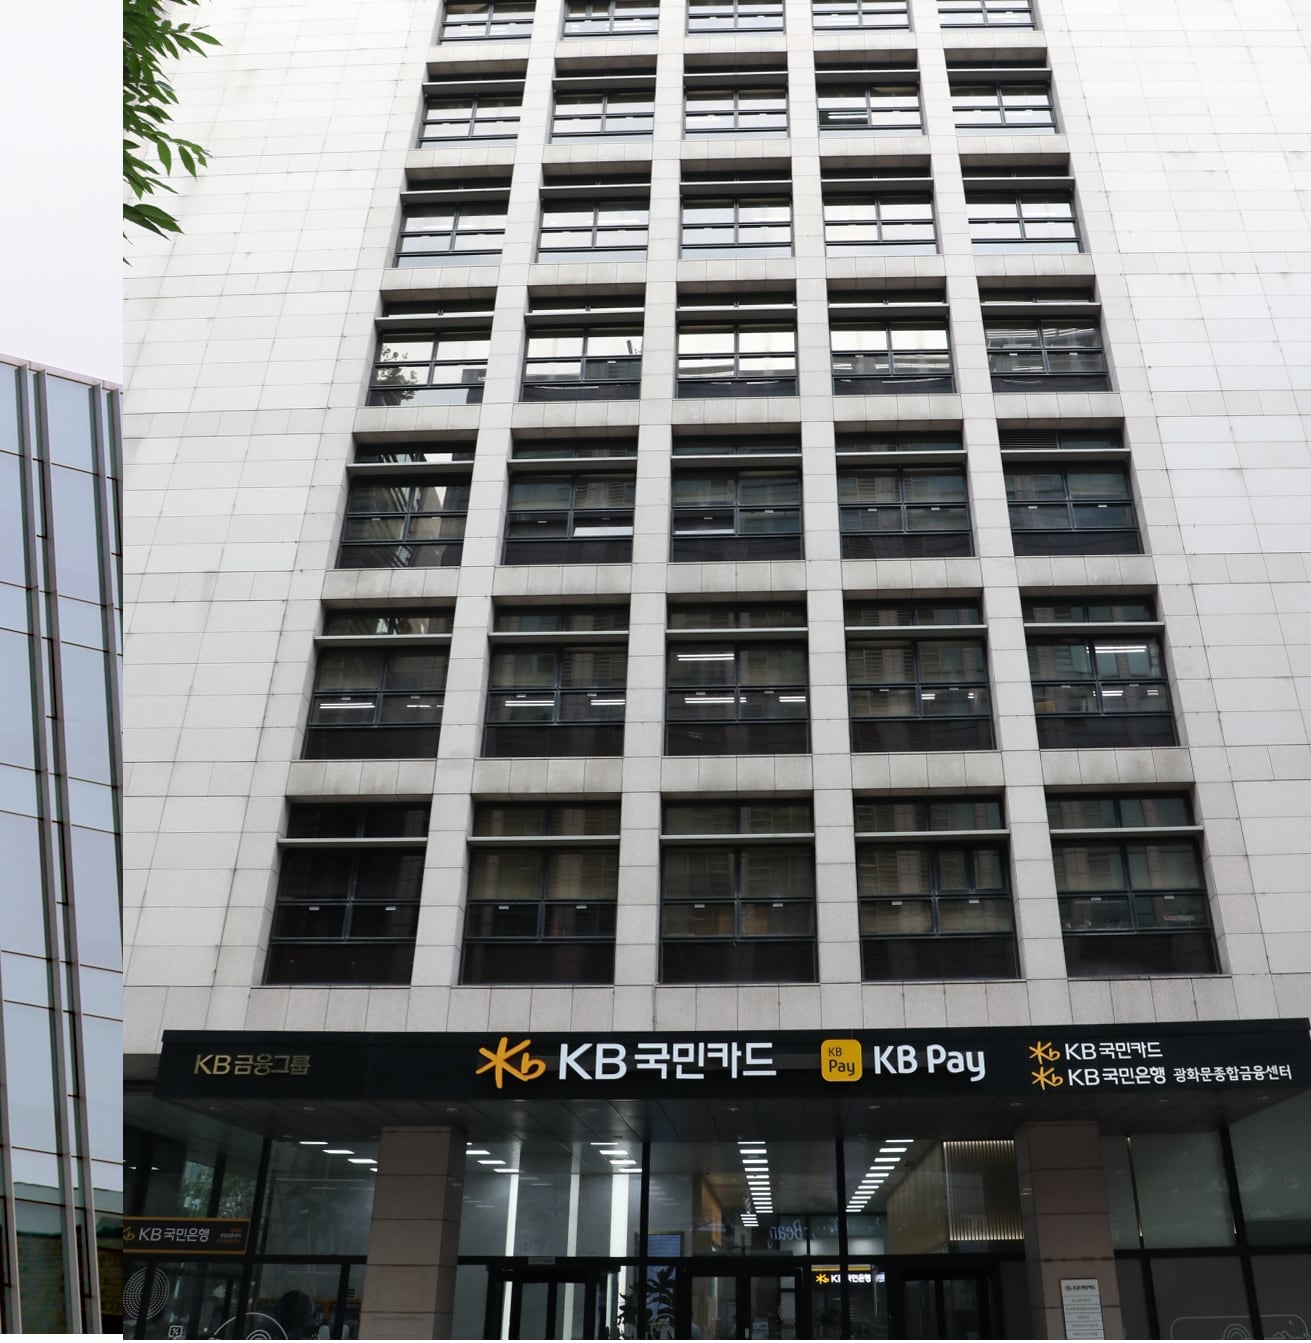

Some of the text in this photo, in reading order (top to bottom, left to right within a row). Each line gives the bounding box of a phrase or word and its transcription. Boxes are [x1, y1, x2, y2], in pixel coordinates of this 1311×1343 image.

[828, 1047, 843, 1057] KB
[828, 1059, 856, 1076] Pay
[873, 1044, 987, 1082] KB Pay
[1173, 1063, 1293, 1084] 광화문종합금융센터
